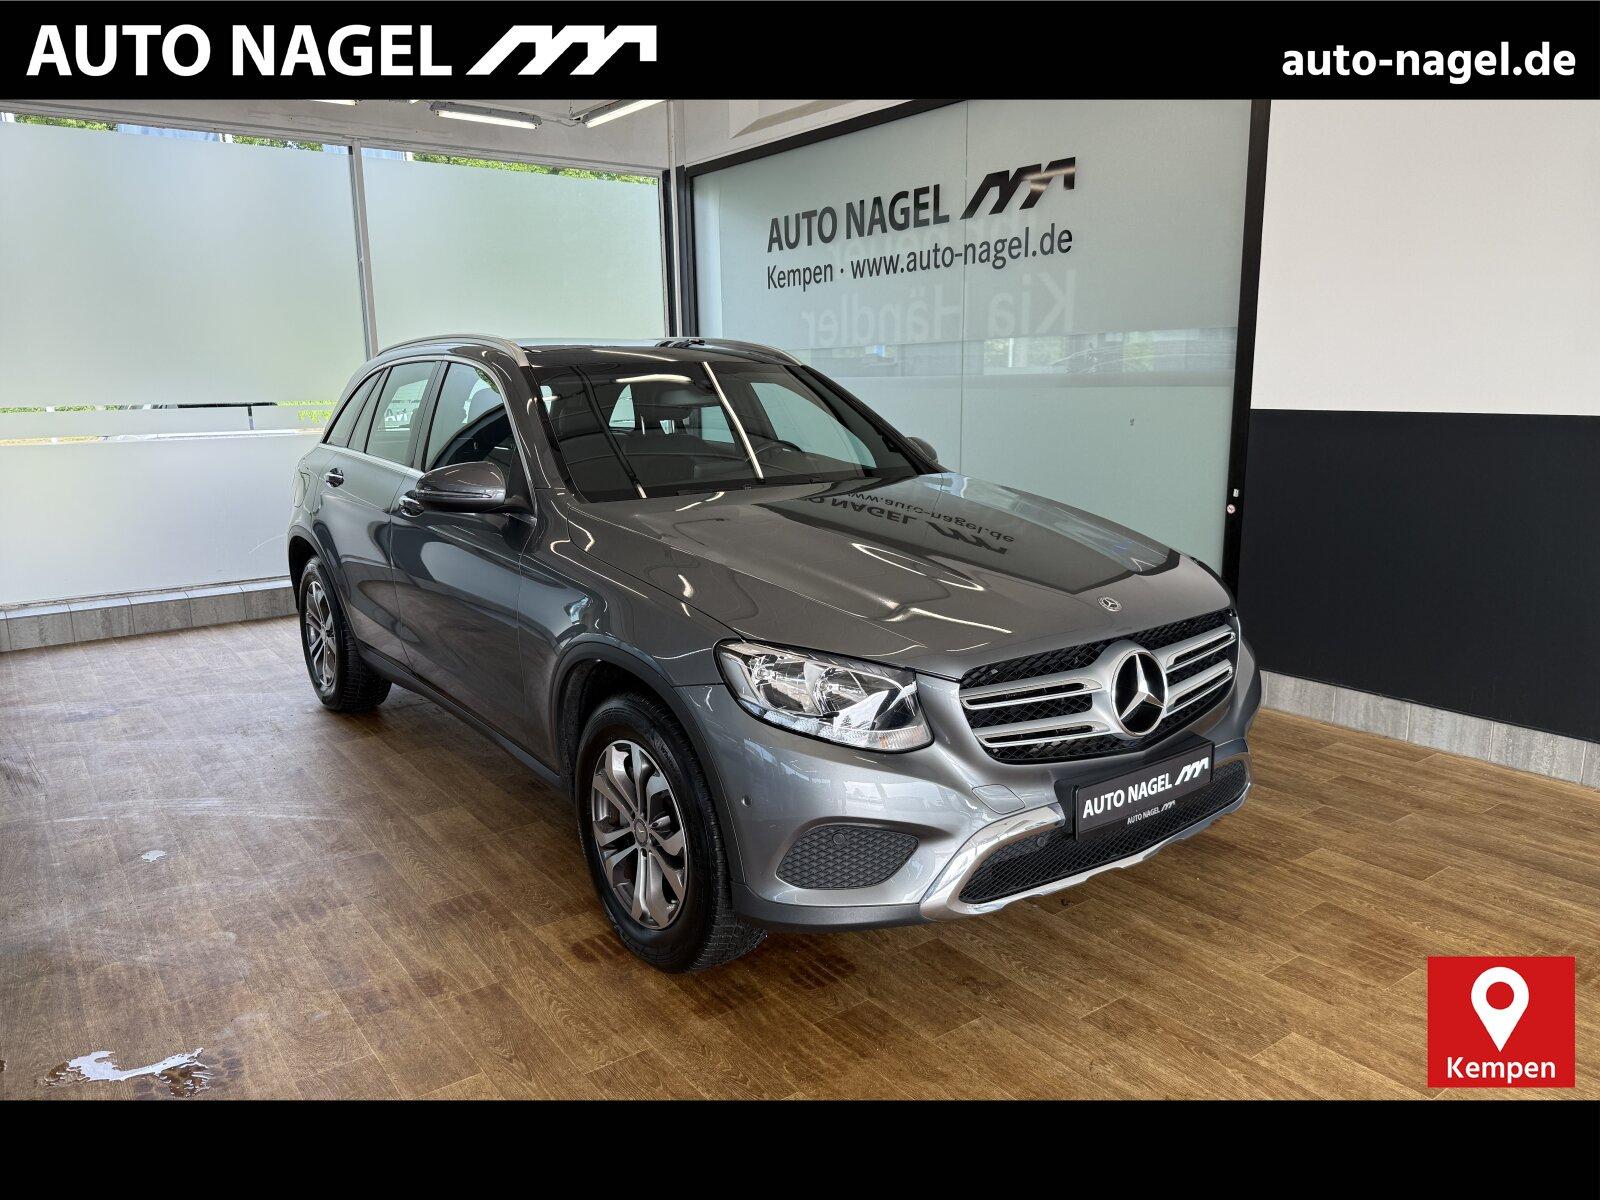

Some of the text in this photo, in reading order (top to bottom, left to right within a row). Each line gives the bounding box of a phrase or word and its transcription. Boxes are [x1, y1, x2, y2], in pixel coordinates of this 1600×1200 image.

[767, 184, 950, 253] AUTO NAGEL
[767, 262, 834, 293] Kempen
[850, 223, 1073, 280] www.auto-nagel.de
[1082, 772, 1173, 819] AUTO NAGEL
[1126, 806, 1161, 825] AUTO NAGEL
